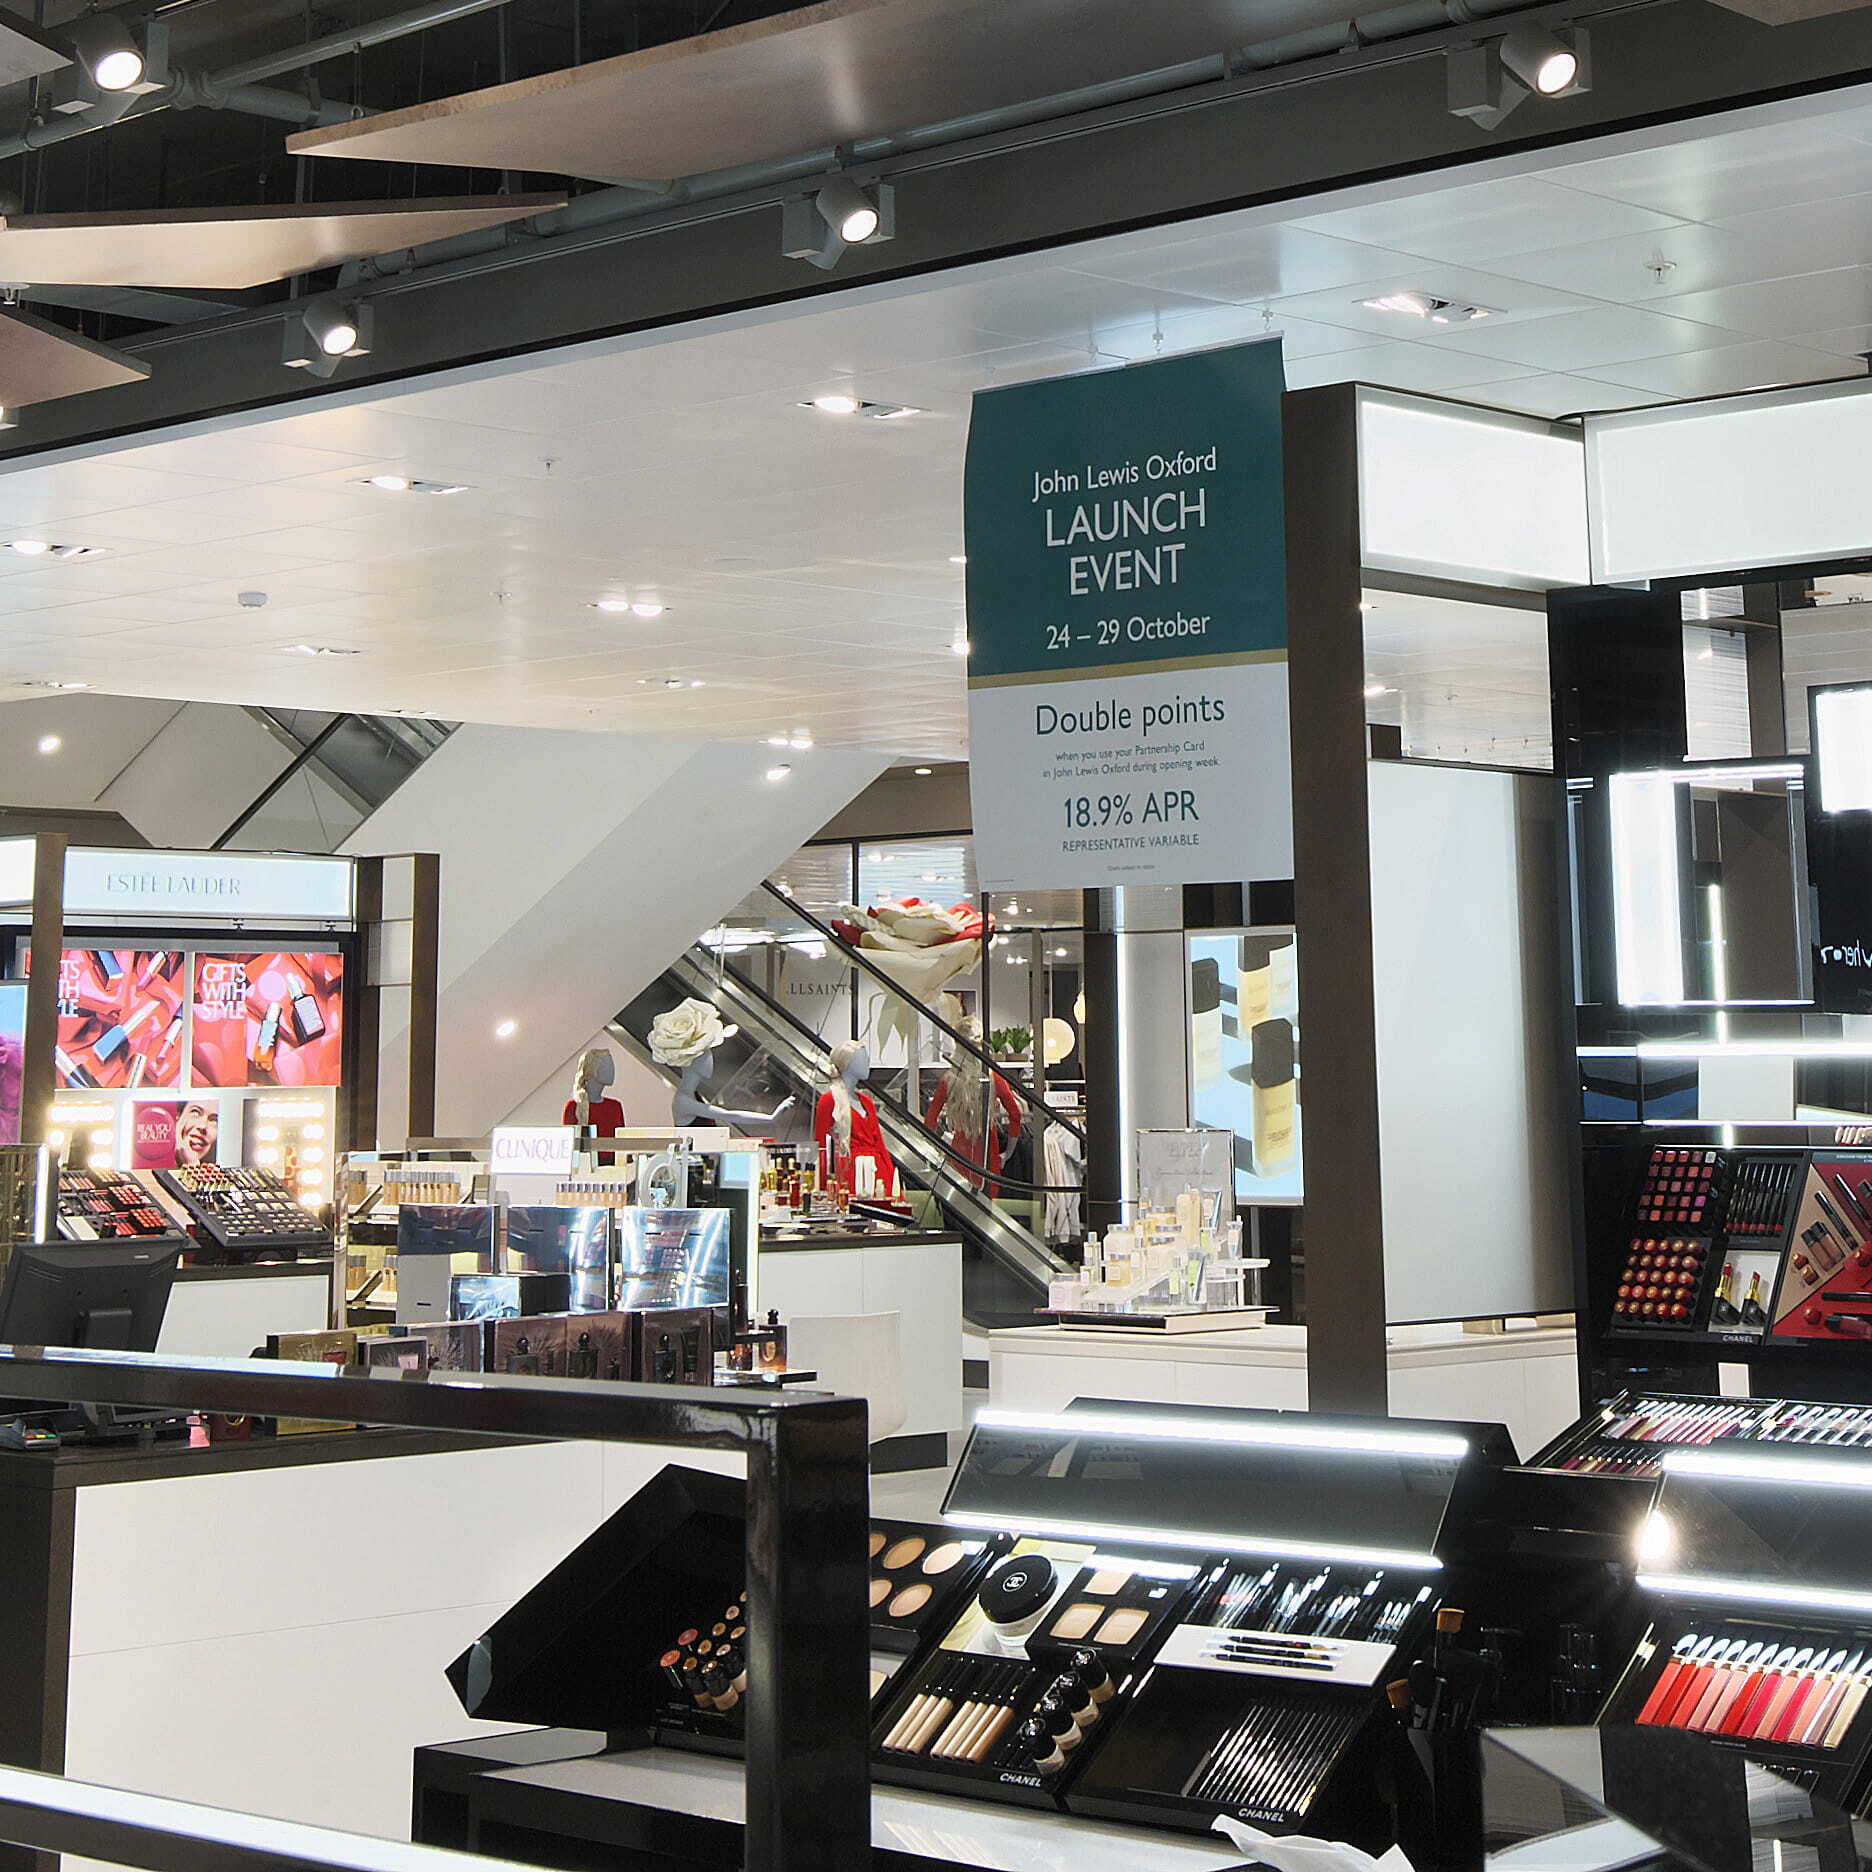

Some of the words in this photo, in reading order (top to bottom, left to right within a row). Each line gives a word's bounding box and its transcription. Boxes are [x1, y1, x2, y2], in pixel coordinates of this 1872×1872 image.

[1032, 469, 1079, 503] John
[1086, 461, 1139, 489] Lewis
[1146, 446, 1217, 480] Oxford
[1046, 487, 1206, 547] LAUNCH
[1070, 543, 1186, 596] EVENT
[1046, 624, 1071, 650] 24
[1097, 620, 1120, 645] 29
[1126, 611, 1211, 642] October
[1036, 699, 1131, 735] Double
[1142, 695, 1225, 736] points
[1056, 751, 1078, 761] when
[1081, 752, 1097, 762] you
[1099, 750, 1112, 759] use
[1115, 748, 1132, 760] your
[1135, 743, 1181, 757] Partnership
[1183, 740, 1205, 752] Card
[1053, 767, 1073, 780] John
[1075, 765, 1098, 777] Lewis
[1101, 762, 1130, 775] Oxford
[1132, 760, 1157, 774] during
[1159, 758, 1192, 771] opening
[1195, 756, 1219, 767] week
[1064, 793, 1133, 828] 18.9%
[1142, 789, 1200, 824] APR
[1062, 836, 1145, 853] REPRESENTATIVE
[1148, 833, 1200, 849] VARIABLE
[167, 875, 241, 895] LAUDER
[202, 963, 246, 982] GIFTS
[202, 982, 246, 1001] WITH
[202, 1001, 246, 1019] STYLE
[495, 1137, 570, 1161] CLINIQUE
[1722, 1334, 1754, 1344] CHANEL
[999, 1772, 1042, 1788] CHANEL
[1238, 1807, 1285, 1823] CHANEL
